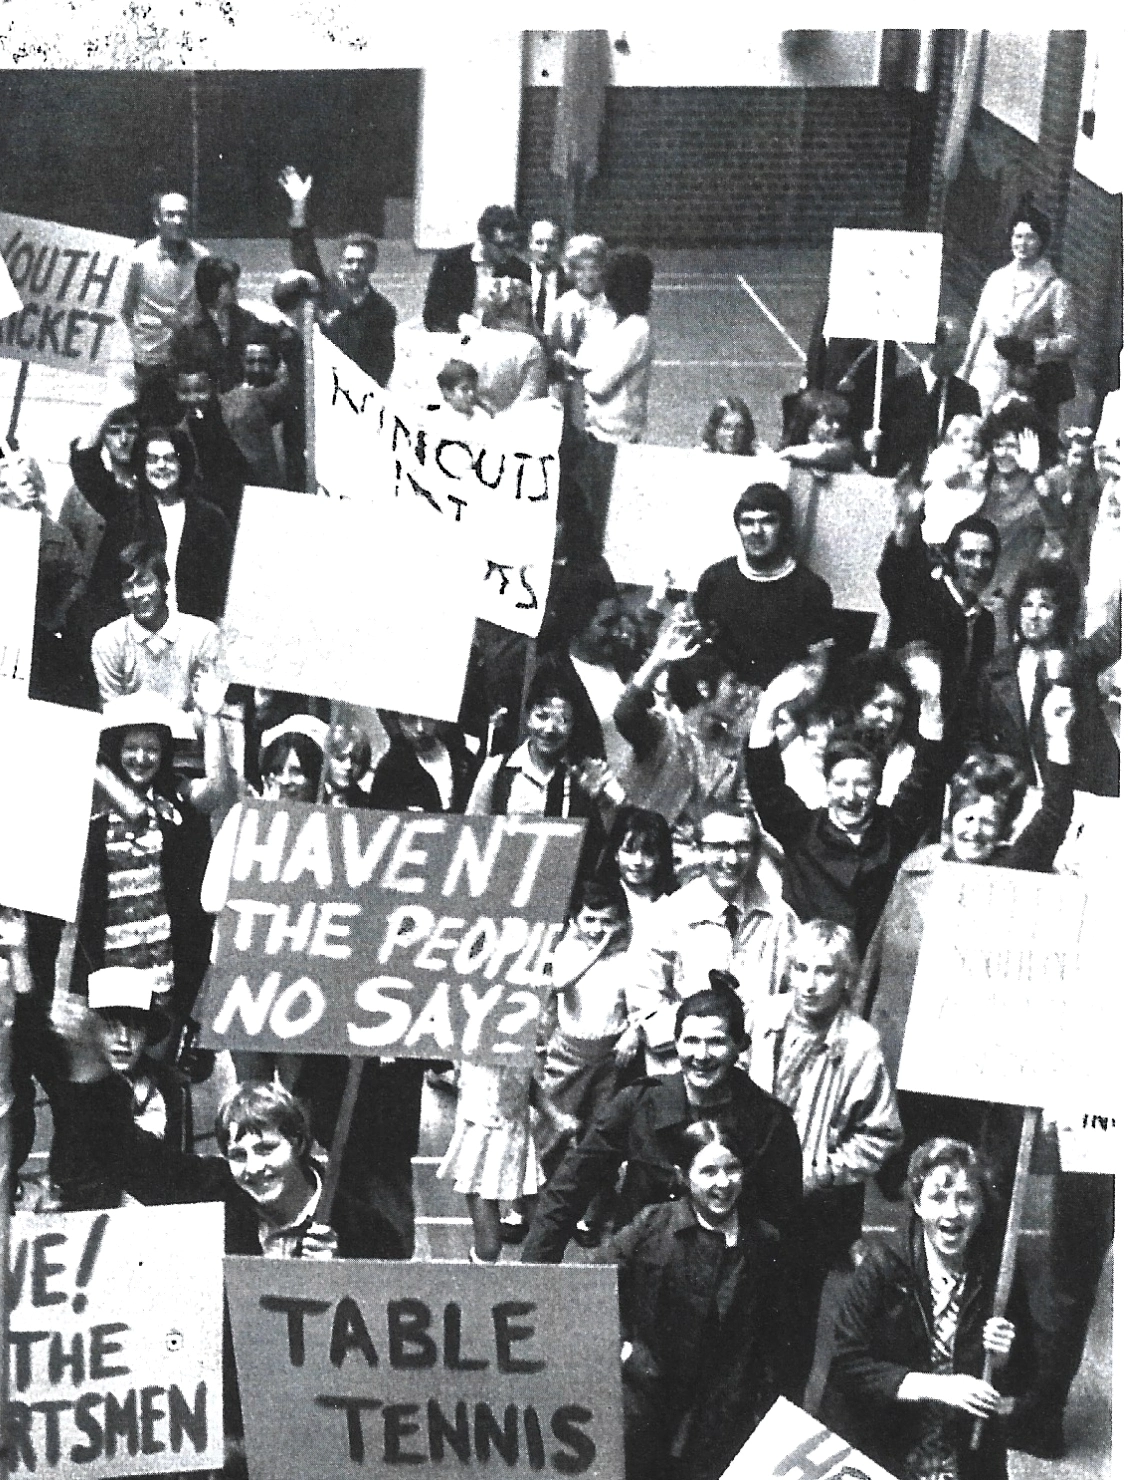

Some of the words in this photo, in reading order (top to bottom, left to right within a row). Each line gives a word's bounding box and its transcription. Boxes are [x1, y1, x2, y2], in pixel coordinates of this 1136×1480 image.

[227, 899, 362, 960] THE
[377, 904, 567, 987] PEOPLE
[212, 971, 327, 1039] NO
[346, 976, 541, 1055] SAY?
[9, 1322, 132, 1394] THE
[259, 1293, 547, 1375] TABLE
[314, 1394, 597, 1475] TENNIS
